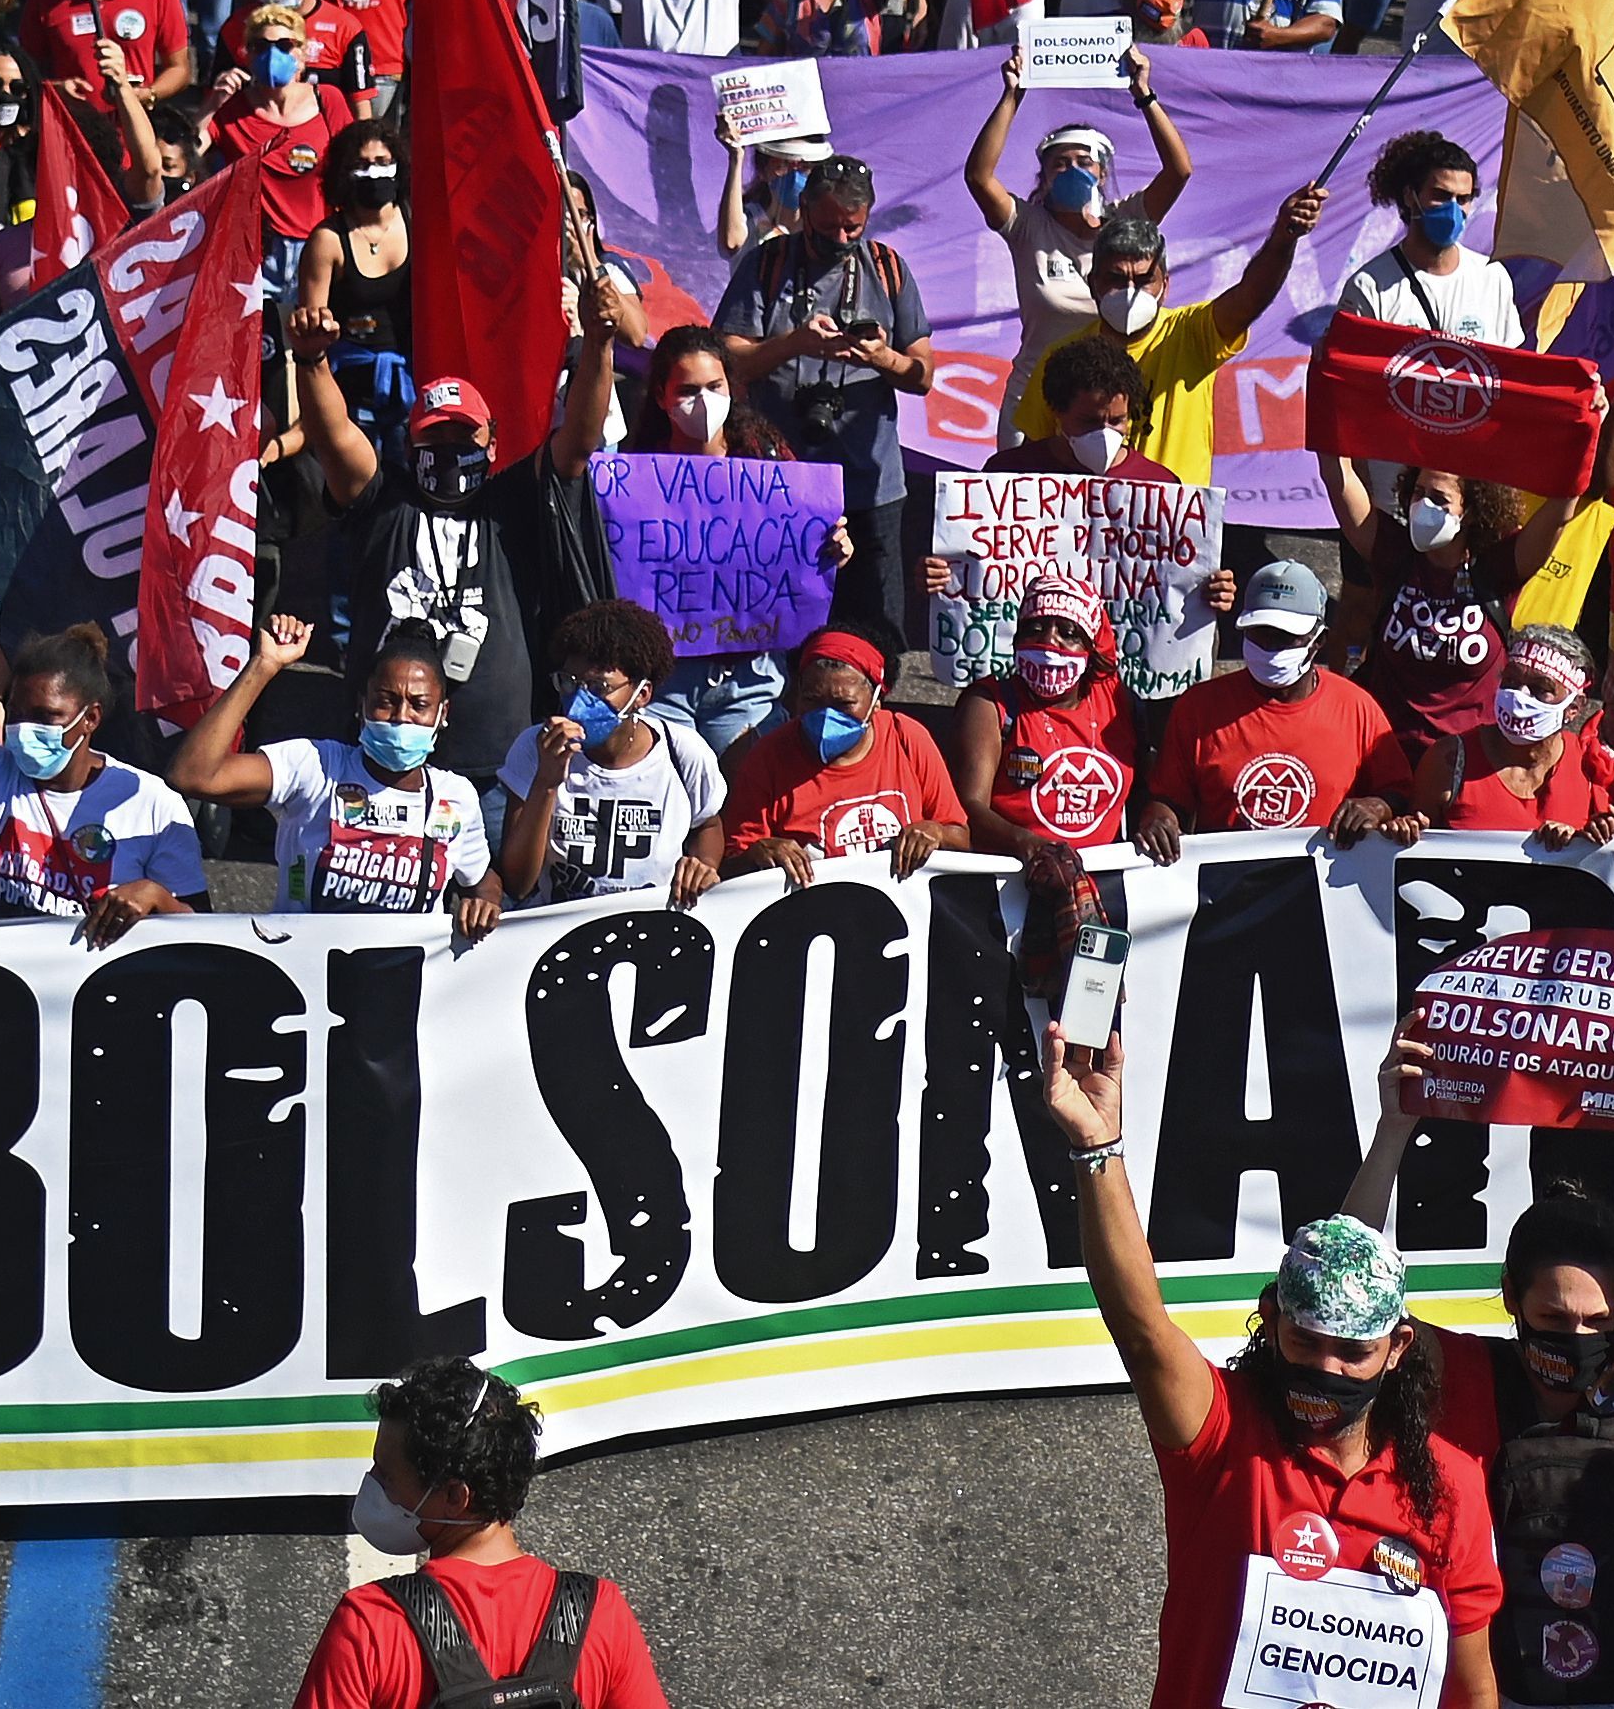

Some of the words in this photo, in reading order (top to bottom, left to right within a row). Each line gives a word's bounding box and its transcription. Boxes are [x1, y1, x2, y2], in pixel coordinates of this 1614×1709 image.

[1034, 36, 1116, 48] BOLSONARO
[1032, 53, 1118, 67] GENOCIDA
[723, 84, 786, 102] TRABALHO
[726, 101, 772, 117] COMIDA
[650, 459, 792, 505] VACINA
[945, 477, 1207, 541] IVERMECTINA
[637, 513, 827, 571] EDUCAÇÃO
[970, 524, 1060, 560] SERVE
[1103, 528, 1197, 567] PIOLHO
[650, 569, 804, 615] RENDA
[557, 816, 586, 836] FORA
[619, 807, 651, 825] FORA
[1055, 811, 1095, 826] BRASIL
[1252, 809, 1288, 822] BRASIL
[1455, 944, 1546, 974] GREVE
[1438, 973, 1501, 998] PARA
[1498, 1051, 1510, 1068] E
[1514, 1051, 1543, 1072] OS
[1436, 1077, 1486, 1095] ESQUERDA
[1270, 1606, 1425, 1649] BOLSONARO
[1259, 1643, 1420, 1692] GENOCIDA
